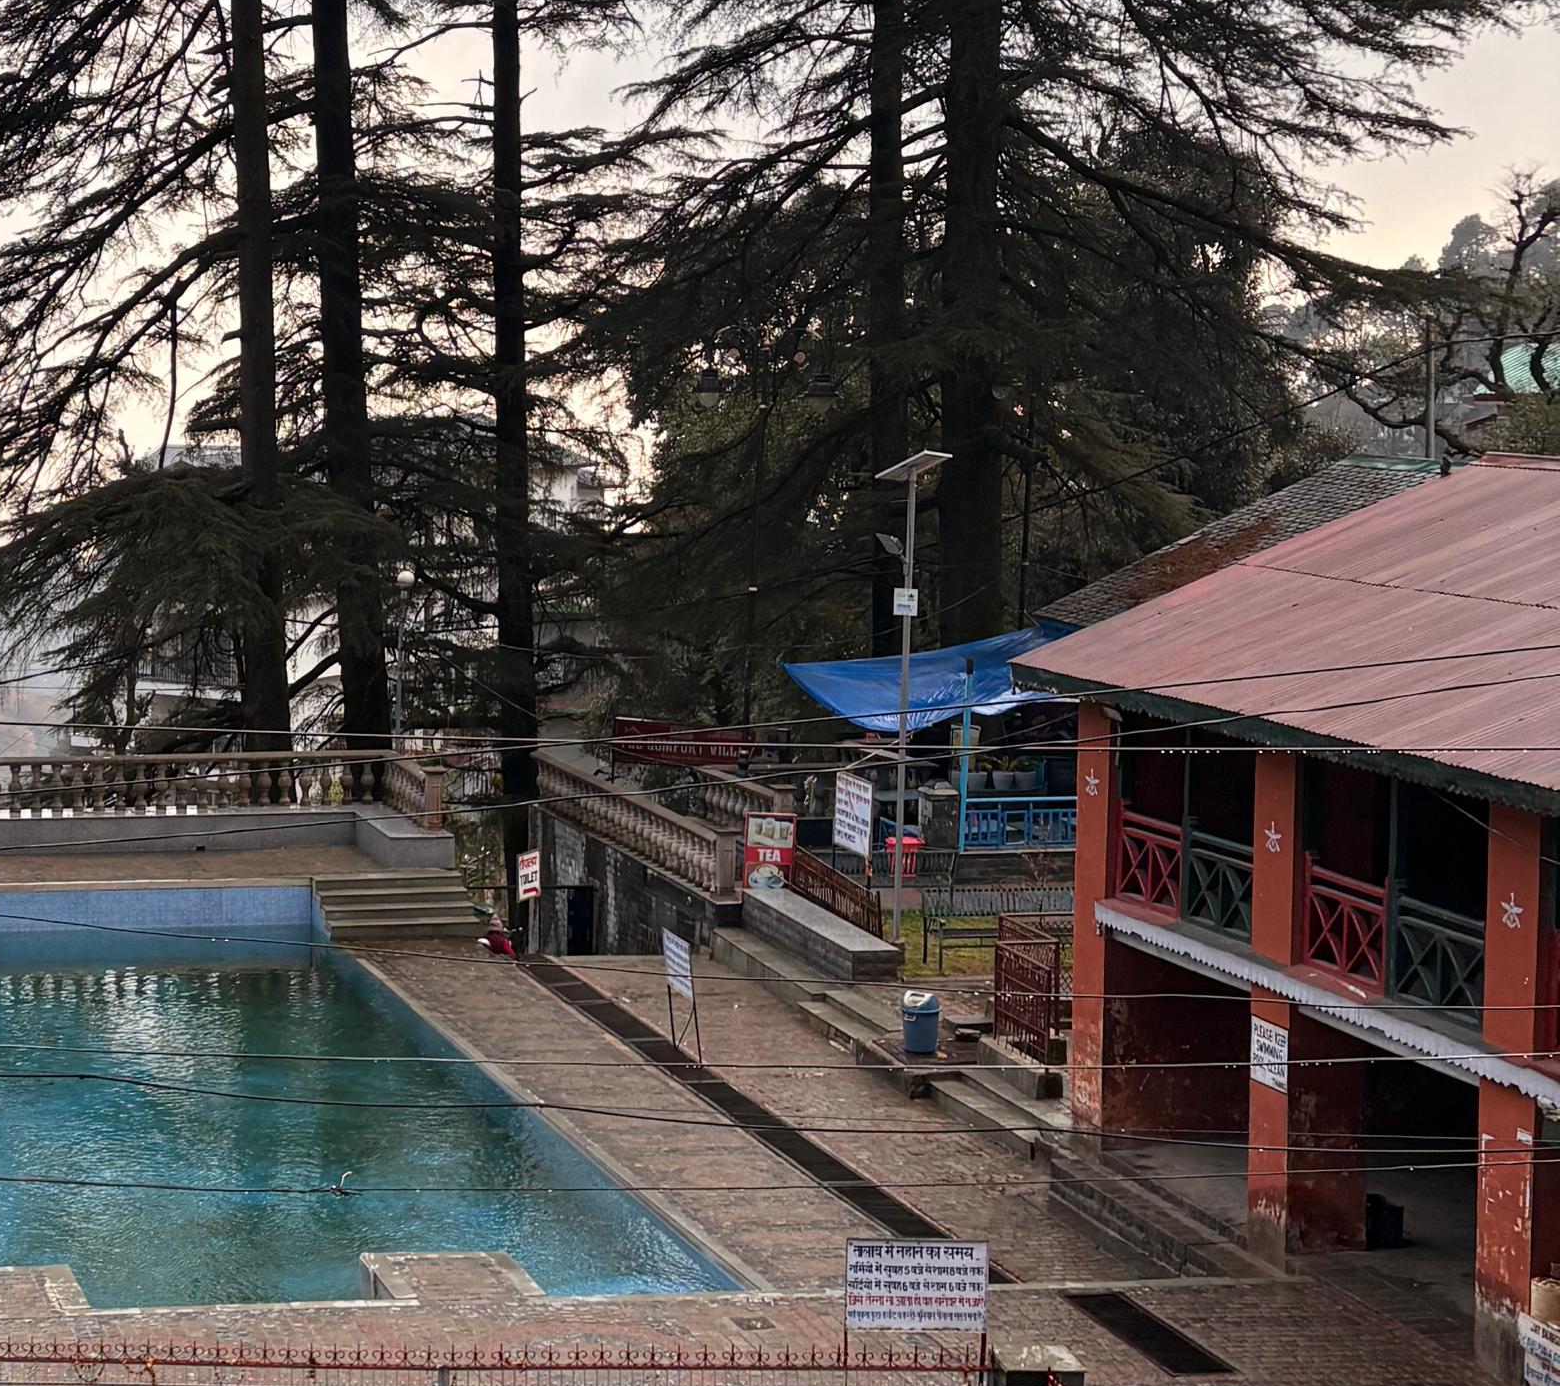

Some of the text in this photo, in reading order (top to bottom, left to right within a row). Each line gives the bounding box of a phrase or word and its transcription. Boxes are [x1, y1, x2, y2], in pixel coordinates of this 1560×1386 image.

[757, 848, 781, 862] TEA
[520, 870, 538, 886] TOILET
[1254, 1023, 1287, 1047] PLEASE KEEP
[1256, 1041, 1283, 1061] SWIMMING
[926, 1246, 940, 1260] का
[944, 1246, 974, 1260] समय
[904, 1267, 910, 1275] 5
[949, 1267, 955, 1276] 8
[903, 1283, 908, 1291] 6
[949, 1283, 954, 1292] 6
